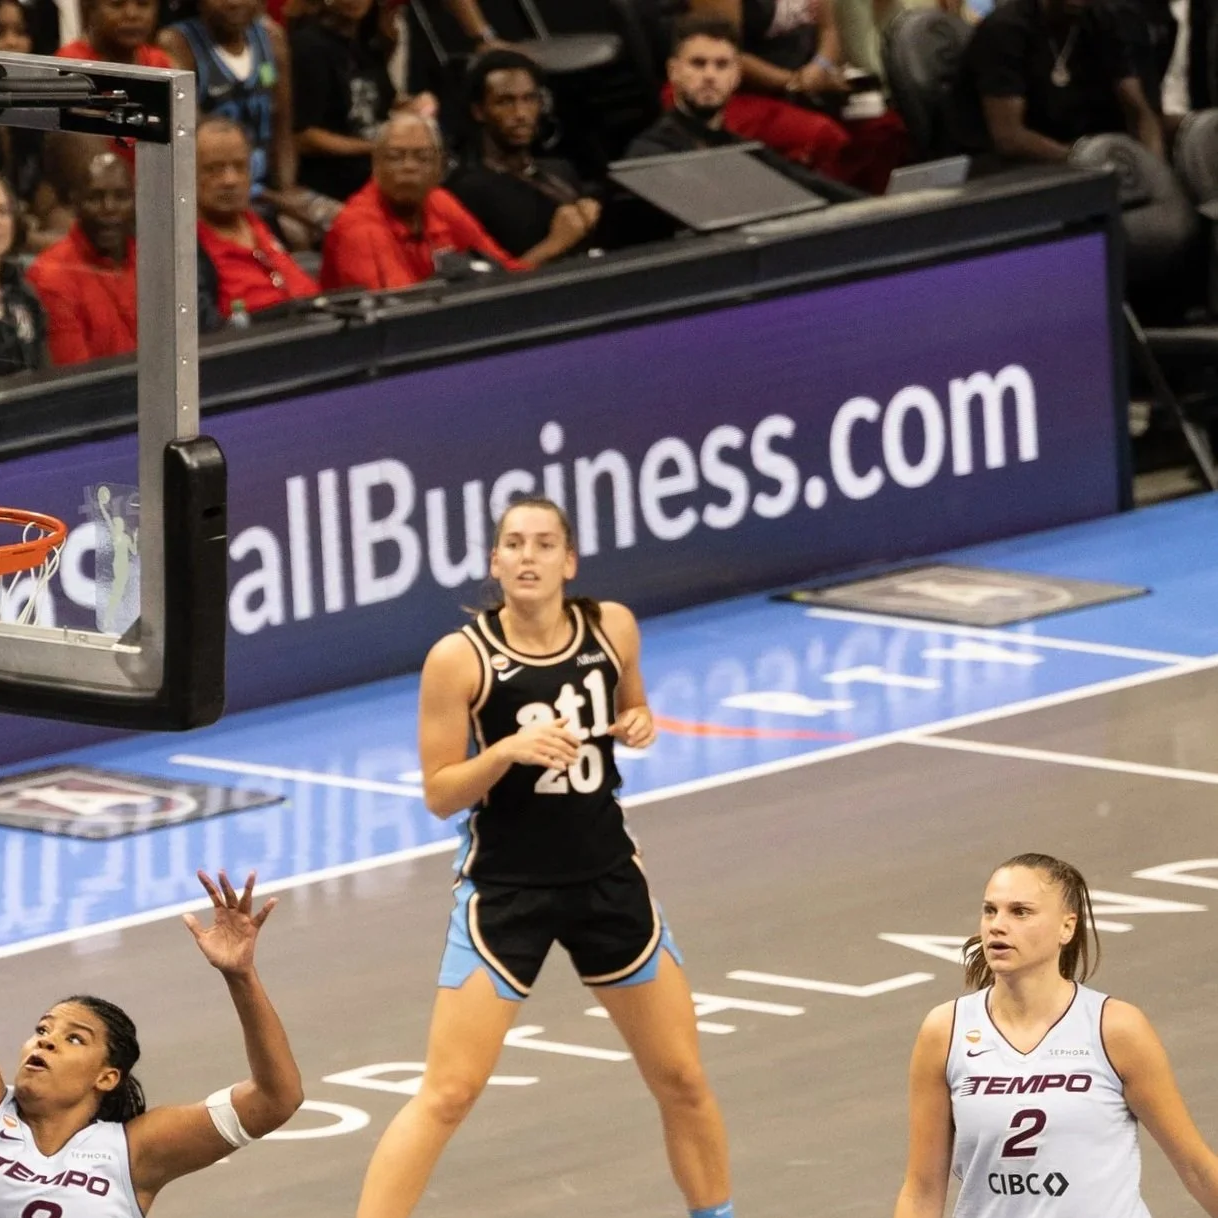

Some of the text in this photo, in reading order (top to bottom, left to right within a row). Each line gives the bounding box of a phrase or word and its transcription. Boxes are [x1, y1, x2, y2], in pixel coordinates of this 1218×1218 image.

[960, 1074, 1093, 1097] TEMPO
[1001, 1108, 1047, 1158] 2
[988, 1173, 1040, 1195] CIBC
